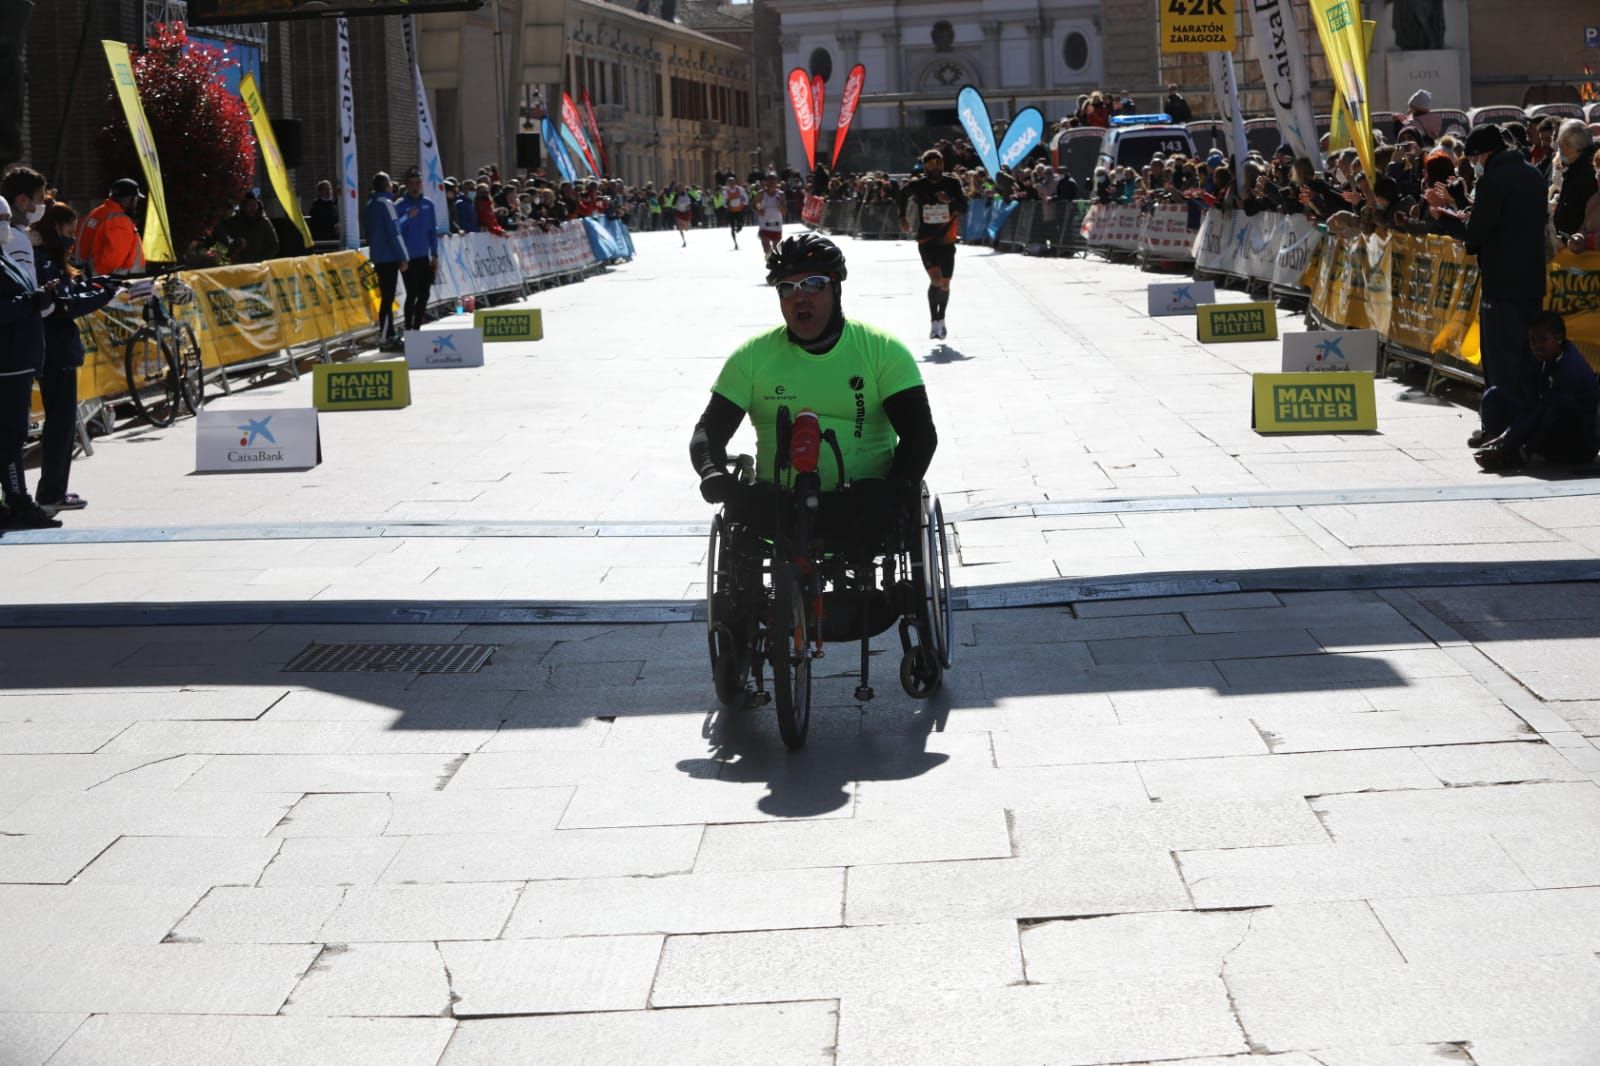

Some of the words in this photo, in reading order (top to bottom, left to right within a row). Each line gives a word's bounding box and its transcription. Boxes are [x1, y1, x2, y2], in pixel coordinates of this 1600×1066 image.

[1172, 22, 1224, 33] MARATÓN
[1170, 34, 1227, 43] ZARAGOZA
[1586, 28, 1598, 42] P
[1001, 127, 1038, 165] HOKA
[1160, 140, 1182, 152] 143
[487, 316, 528, 326] MANN
[1213, 311, 1262, 323] MANN
[487, 325, 529, 335] FILTER
[1214, 322, 1263, 334] FILTER
[331, 373, 390, 386] MANN
[331, 386, 391, 400] FILTER
[1278, 387, 1352, 403] MANN
[1279, 402, 1353, 419] FILTER
[227, 450, 285, 463] CaixaBank
